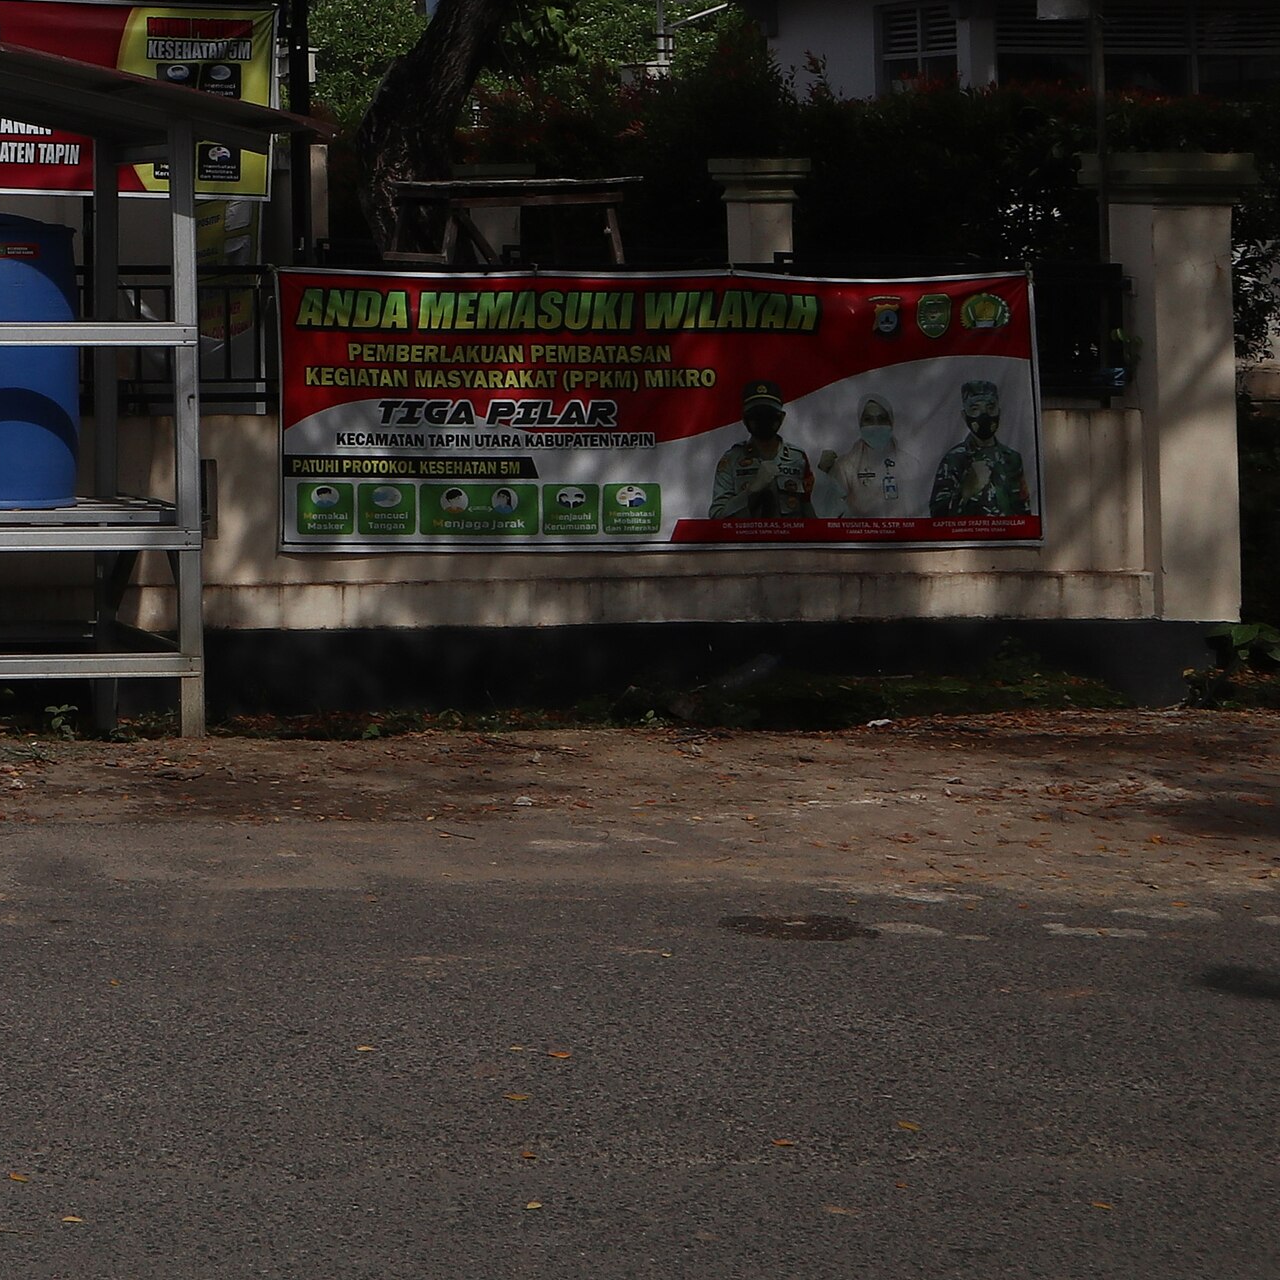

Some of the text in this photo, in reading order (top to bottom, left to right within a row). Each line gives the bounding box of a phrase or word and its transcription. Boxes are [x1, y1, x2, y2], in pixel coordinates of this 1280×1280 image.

[147, 39, 251, 60] KESEHATAN 5M
[37, 142, 81, 165] TAPIN
[295, 288, 409, 330] ANDA
[417, 290, 635, 331] MEMASUKI
[643, 290, 818, 331] WILAYAH
[347, 342, 672, 364] PEMBERLAKUAN PEMBATASAN
[305, 366, 717, 391] KEGIATAN MASYARAKAT (PPKM) MIKRO
[377, 399, 618, 426] TIGA PILAR
[335, 431, 655, 449] KECAMATAN TAPIN UTARA KABUPATEN TAPIN
[291, 459, 521, 475] PATUHI PROTOKOL KESEHATAN 5M
[365, 511, 409, 521] Mencuci
[551, 512, 592, 522] Menjauhi
[608, 510, 656, 518] Membatasi
[306, 522, 346, 531] Masker
[367, 522, 406, 531] Tangan
[432, 519, 490, 532] Menjaga
[543, 522, 598, 531] Kerumunan
